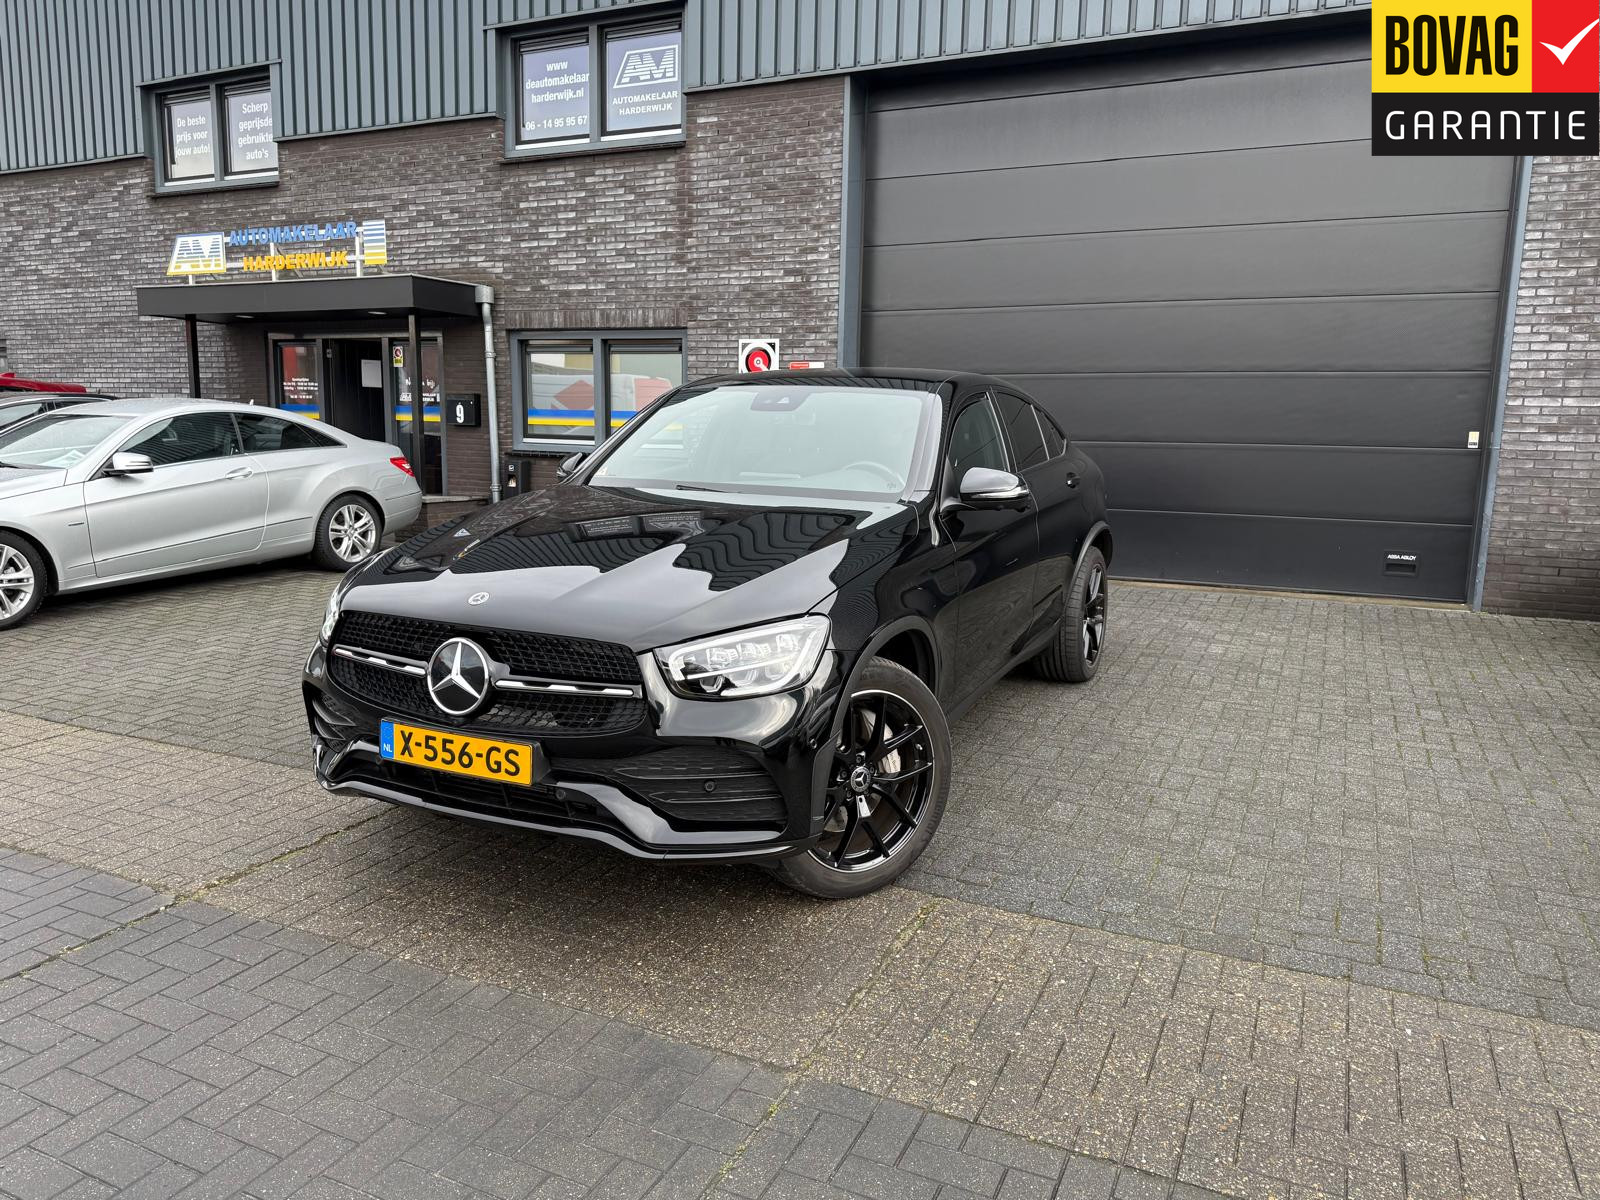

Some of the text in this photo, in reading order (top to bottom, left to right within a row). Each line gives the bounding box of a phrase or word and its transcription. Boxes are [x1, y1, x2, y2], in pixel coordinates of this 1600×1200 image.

[546, 60, 568, 72] www
[525, 73, 589, 90] deautomakelaar
[531, 88, 584, 103] harderwijk.nl
[612, 90, 678, 105] AUTOMAKELAAR
[242, 102, 268, 114] Scherp
[619, 103, 673, 116] HARDERWIJK
[177, 115, 206, 127] De beste
[239, 116, 272, 132] geprijsde
[525, 121, 536, 131] 06
[543, 119, 552, 129] 14
[554, 118, 564, 127] 95
[566, 117, 576, 126] 95
[577, 115, 588, 125] 67
[176, 130, 208, 144] prijs voor
[238, 132, 273, 148] gebruikte
[193, 144, 210, 154] auto!
[246, 149, 269, 160] auto's
[229, 221, 357, 246] AUTOMAKELAAR
[243, 250, 348, 271] HARDERWIJK
[456, 404, 464, 423] 9
[383, 743, 393, 753] NL
[400, 730, 520, 777] X-556-GS
